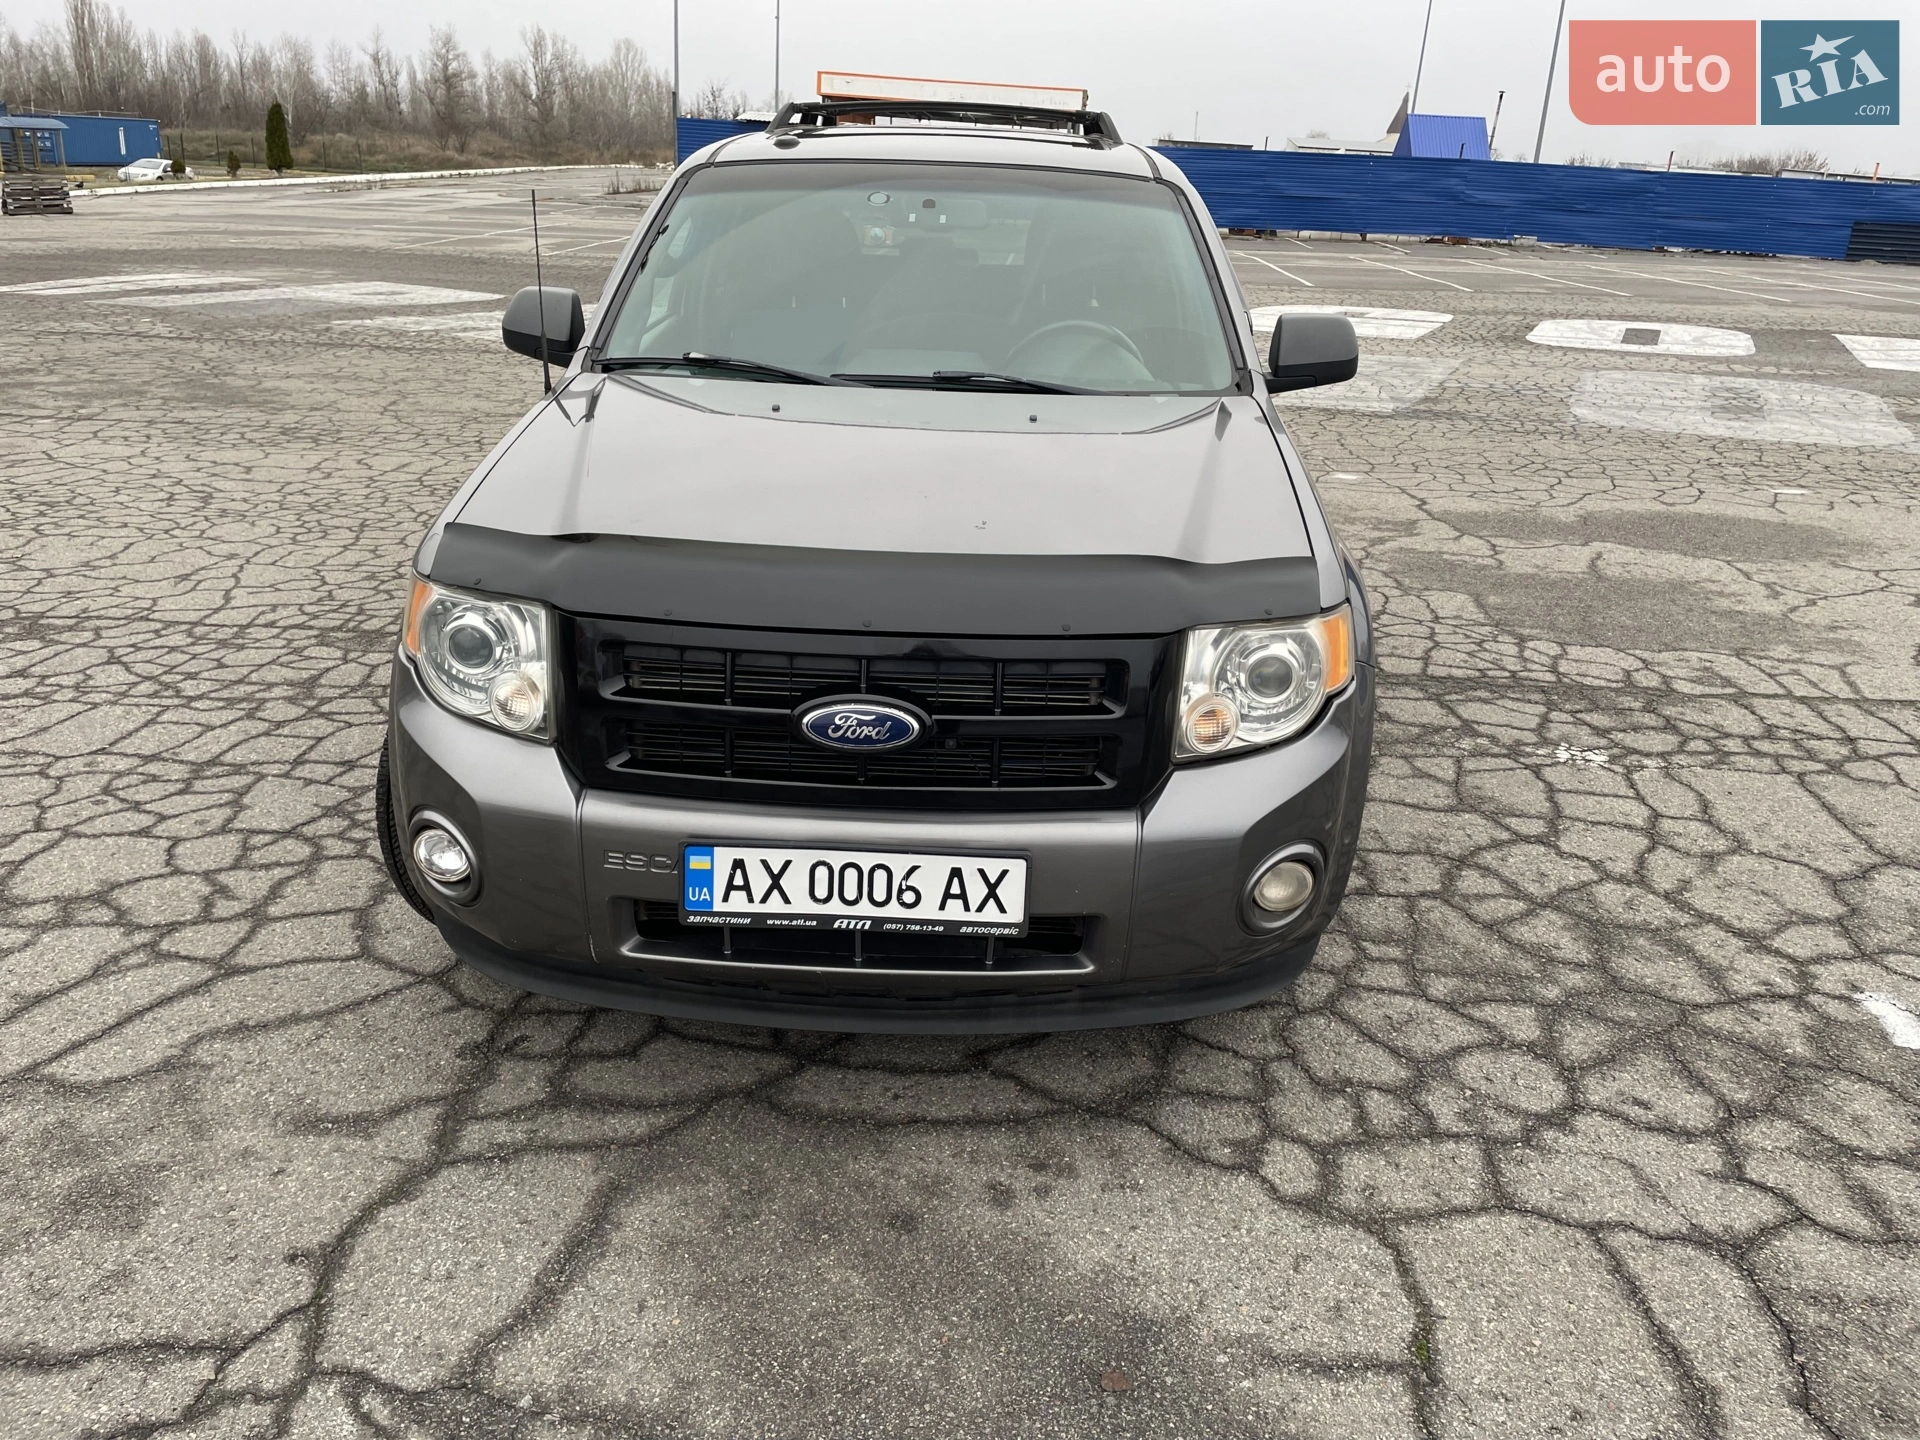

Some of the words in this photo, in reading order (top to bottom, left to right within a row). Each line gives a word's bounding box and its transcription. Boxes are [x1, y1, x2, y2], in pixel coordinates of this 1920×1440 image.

[827, 712, 892, 740] Ford
[603, 849, 679, 874] ESC
[721, 857, 794, 905] AX
[807, 858, 922, 910] 0006
[937, 865, 1011, 914] AX
[688, 886, 712, 902] UA
[686, 915, 752, 925] запчастини
[766, 917, 817, 926] www.atl.ua
[883, 923, 904, 931] (057)
[905, 924, 944, 932] 758-13-49
[959, 926, 1020, 936] автосервіс
